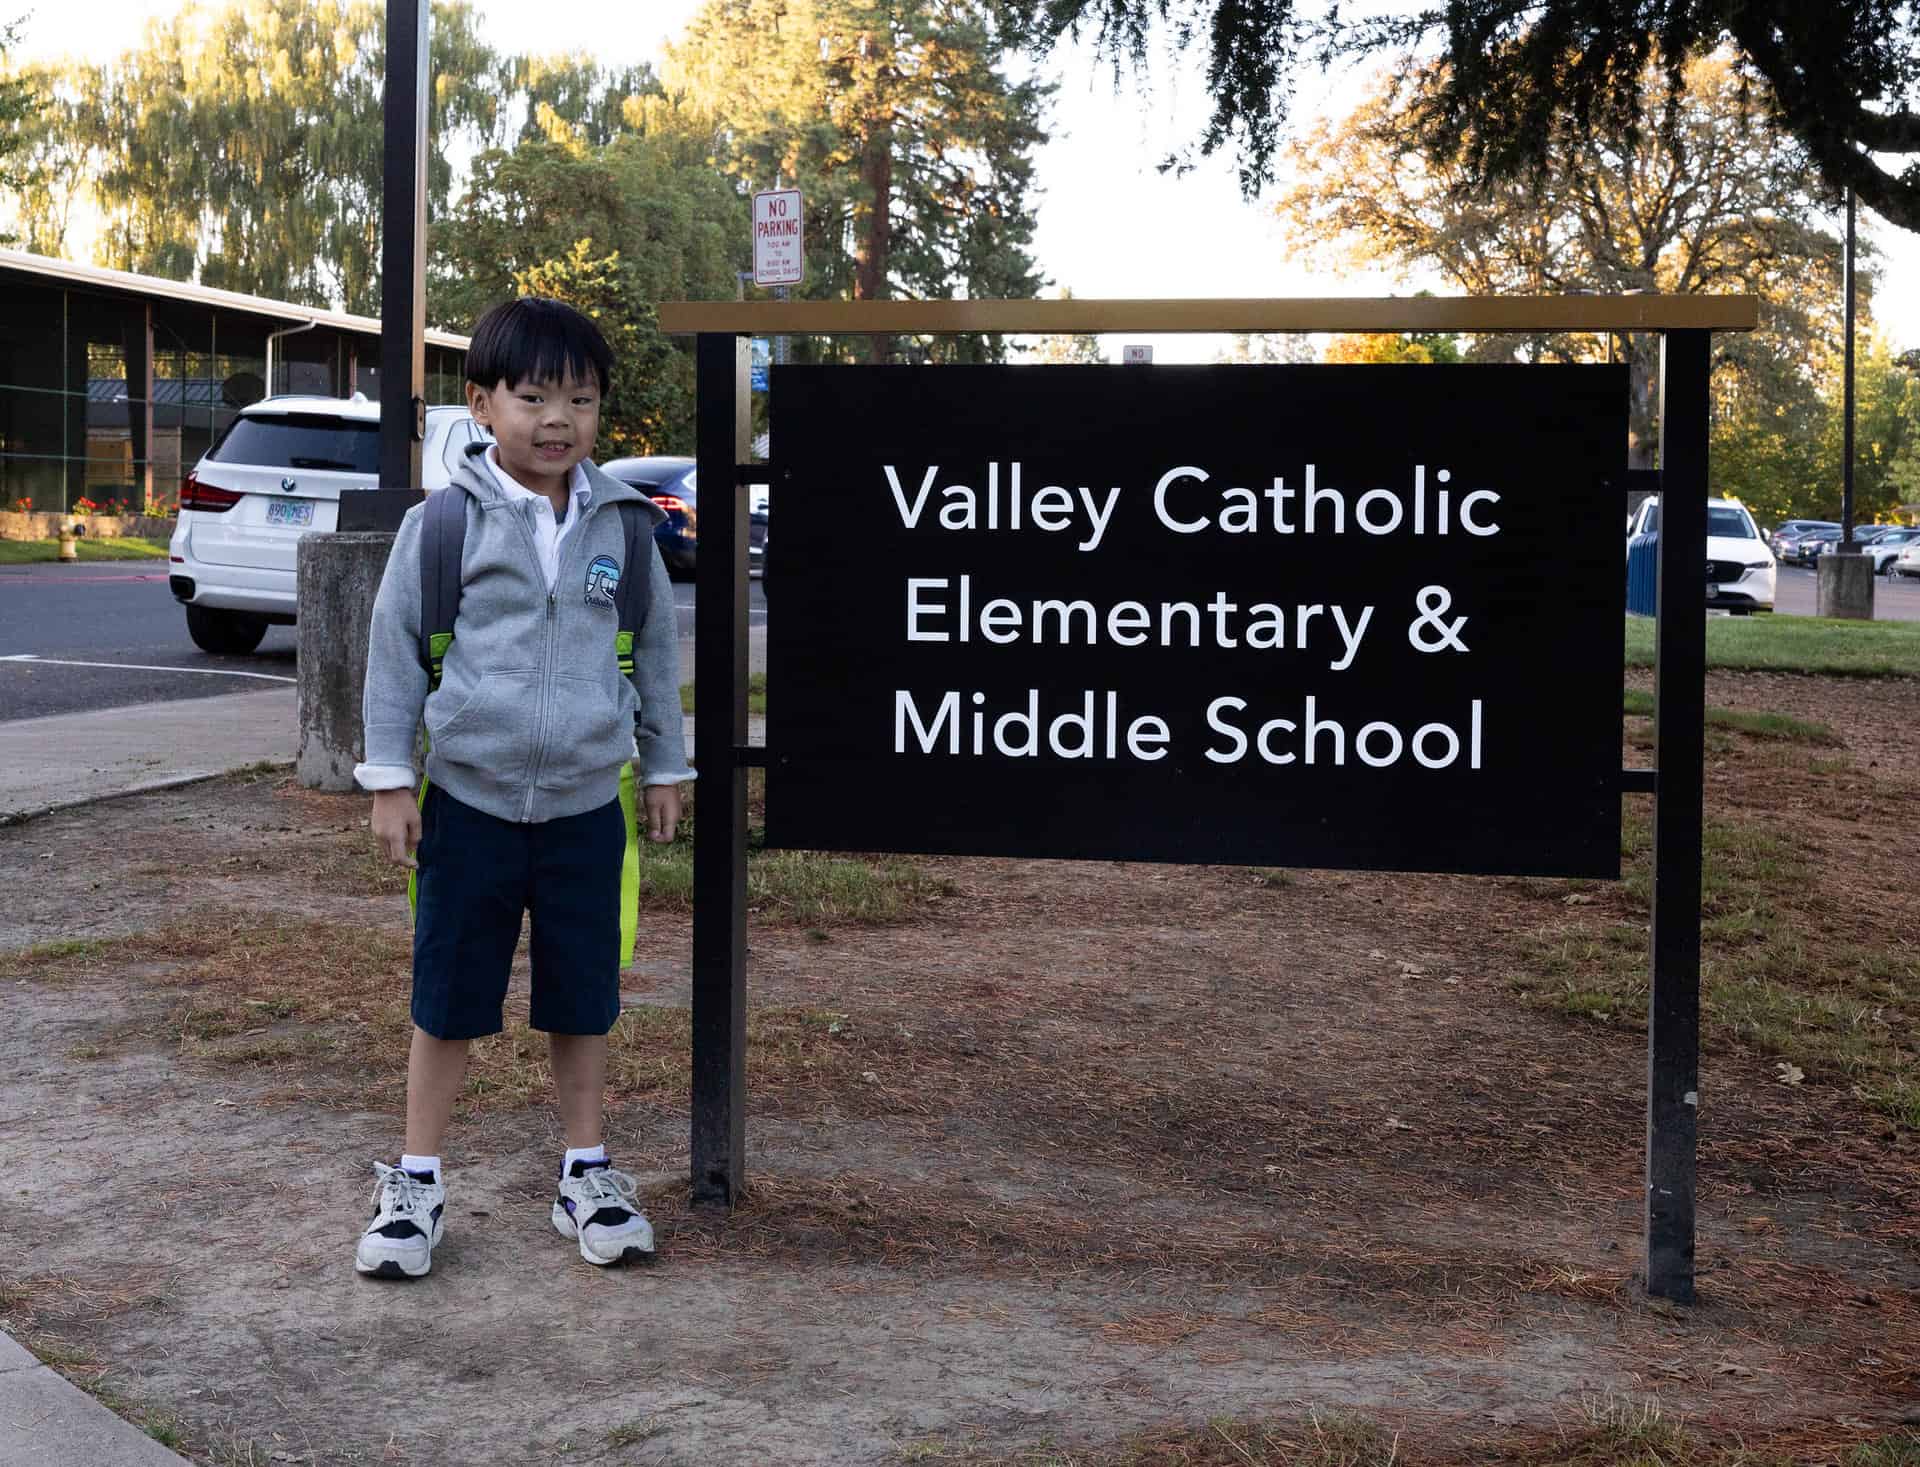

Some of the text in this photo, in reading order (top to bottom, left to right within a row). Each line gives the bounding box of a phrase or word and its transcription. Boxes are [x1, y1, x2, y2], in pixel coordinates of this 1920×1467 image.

[758, 220, 798, 238] PARKING
[769, 200, 786, 217] NO
[1132, 348, 1144, 359] NO
[884, 462, 1501, 553] Valley Catholic
[907, 575, 1470, 671] Elementary &
[895, 689, 1482, 769] Middle School
